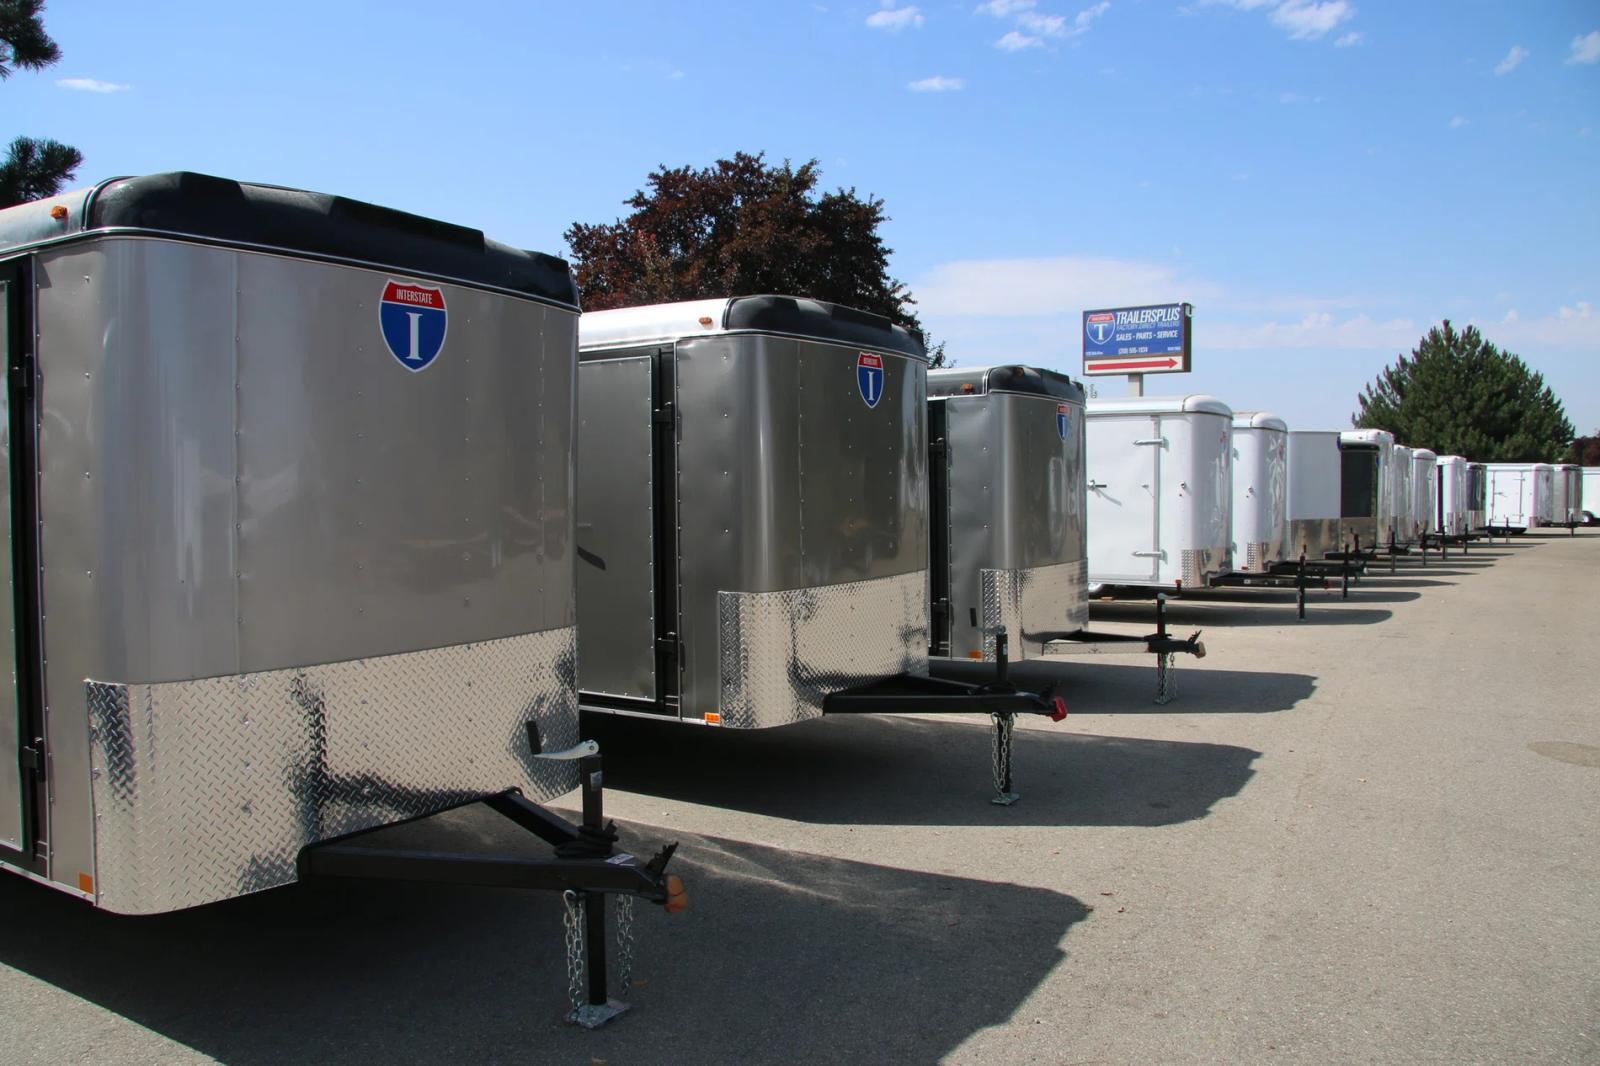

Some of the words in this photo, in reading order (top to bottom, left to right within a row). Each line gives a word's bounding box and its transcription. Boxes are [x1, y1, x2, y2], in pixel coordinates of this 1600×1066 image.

[396, 288, 433, 304] INTERSTATE
[1116, 307, 1181, 325] TRAILERSPLUS
[405, 311, 424, 361] I
[1094, 323, 1108, 340] T
[1116, 333, 1132, 341] SALES
[1136, 331, 1152, 340] PARTS
[1157, 329, 1178, 339] SERVICE
